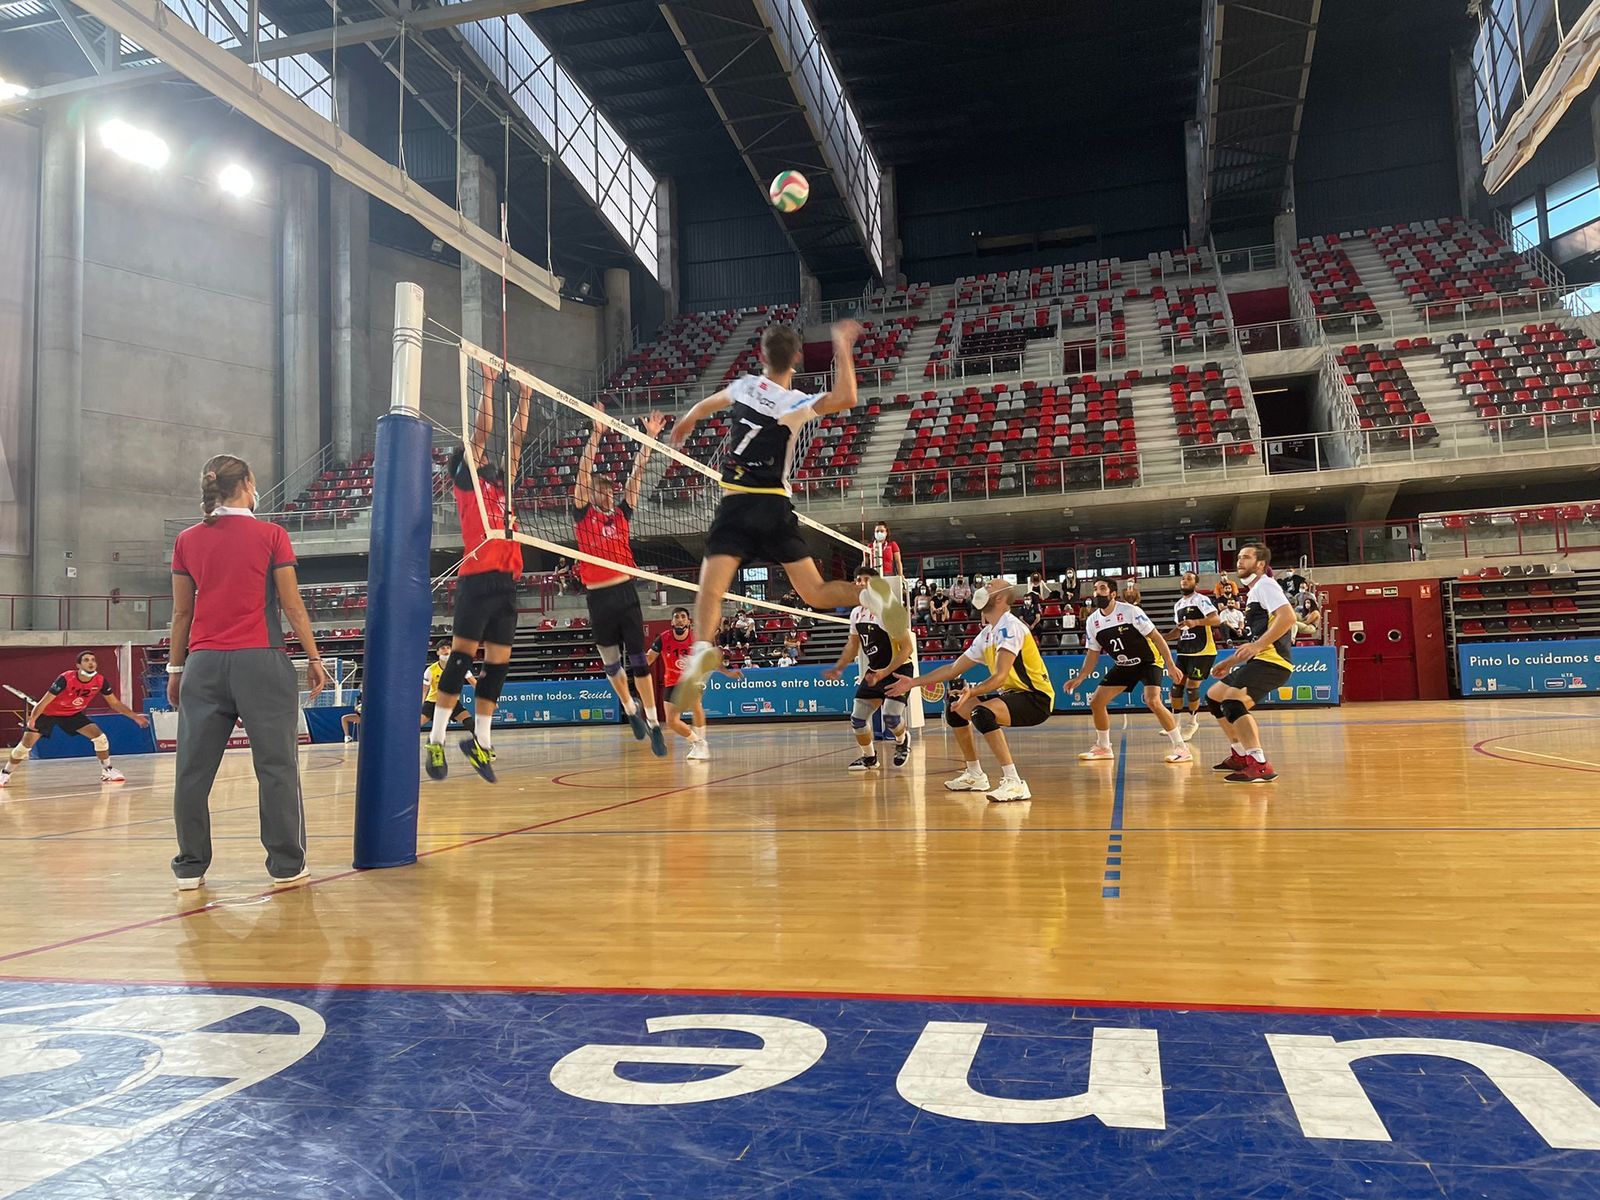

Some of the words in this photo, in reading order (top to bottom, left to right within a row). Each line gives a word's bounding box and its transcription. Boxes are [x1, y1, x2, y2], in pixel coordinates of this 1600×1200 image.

[733, 417, 763, 456] 7
[860, 633, 869, 647] 17
[1109, 637, 1124, 652] 21
[1469, 655, 1503, 667] Pinto
[1507, 653, 1520, 665] lo
[1525, 652, 1589, 665] cuidamos
[710, 679, 721, 690] lo
[725, 678, 777, 690] cuidamos
[781, 679, 810, 688] entre
[75, 688, 91, 698] 12
[463, 694, 472, 704] lo
[520, 691, 544, 701] entre
[546, 691, 576, 701] todos.
[578, 689, 612, 700] Recicla
